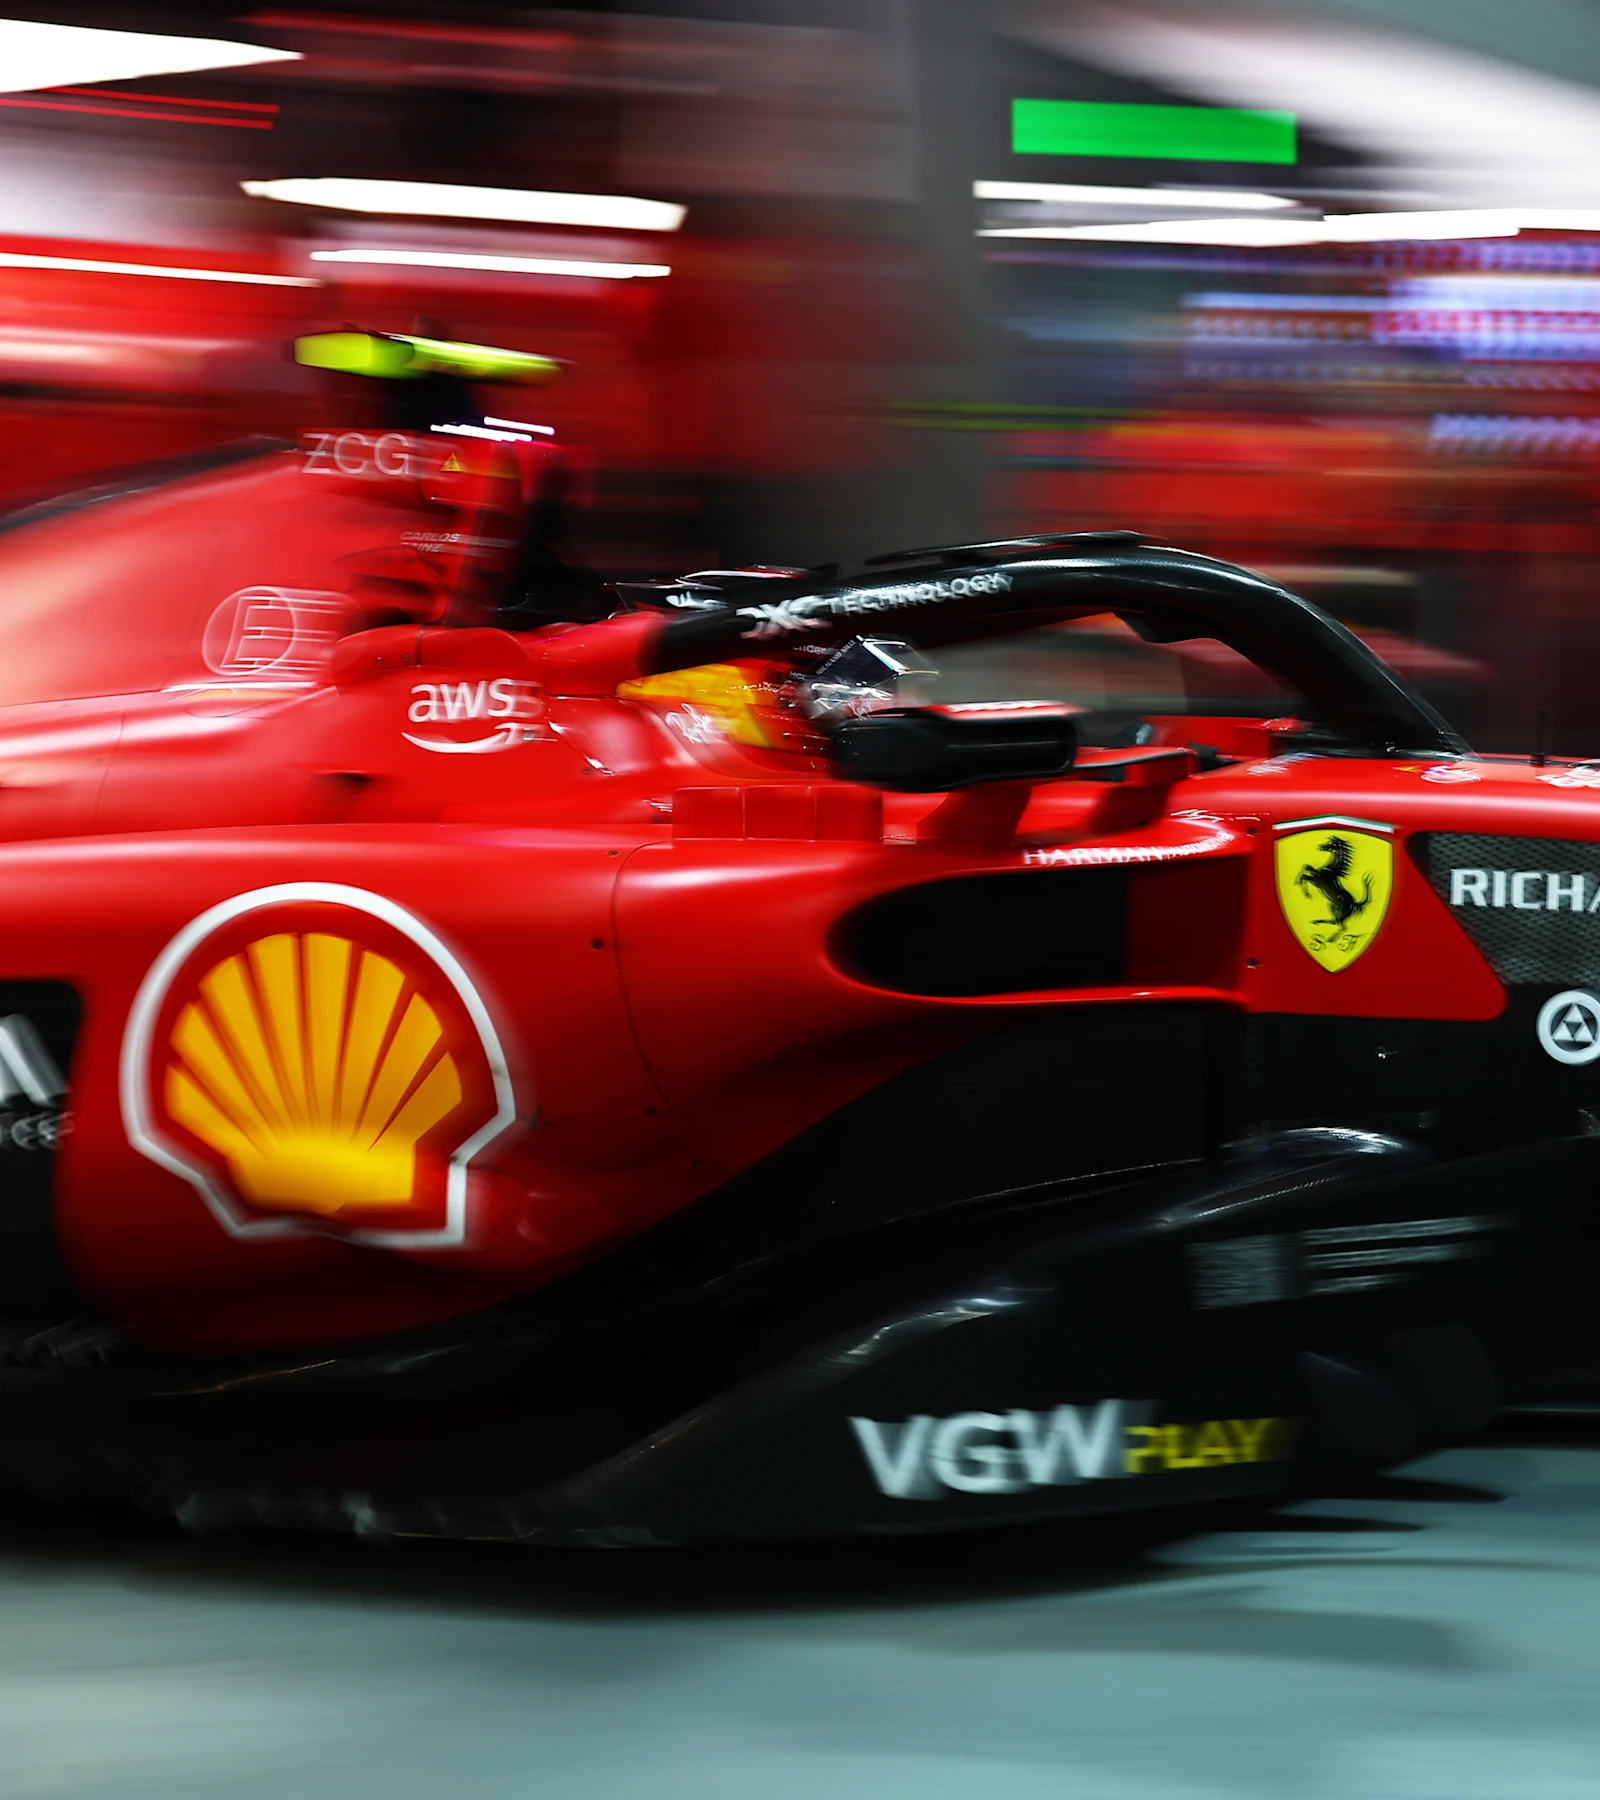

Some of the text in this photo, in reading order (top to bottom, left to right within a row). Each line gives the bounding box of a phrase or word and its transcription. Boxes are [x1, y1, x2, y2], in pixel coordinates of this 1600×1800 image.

[400, 531, 461, 543] CARLOS
[826, 573, 1014, 617] TECHNOLOGY
[407, 677, 516, 723] aws
[1022, 848, 1170, 865] HARMAN
[846, 1399, 1272, 1500] VGW PLAY
